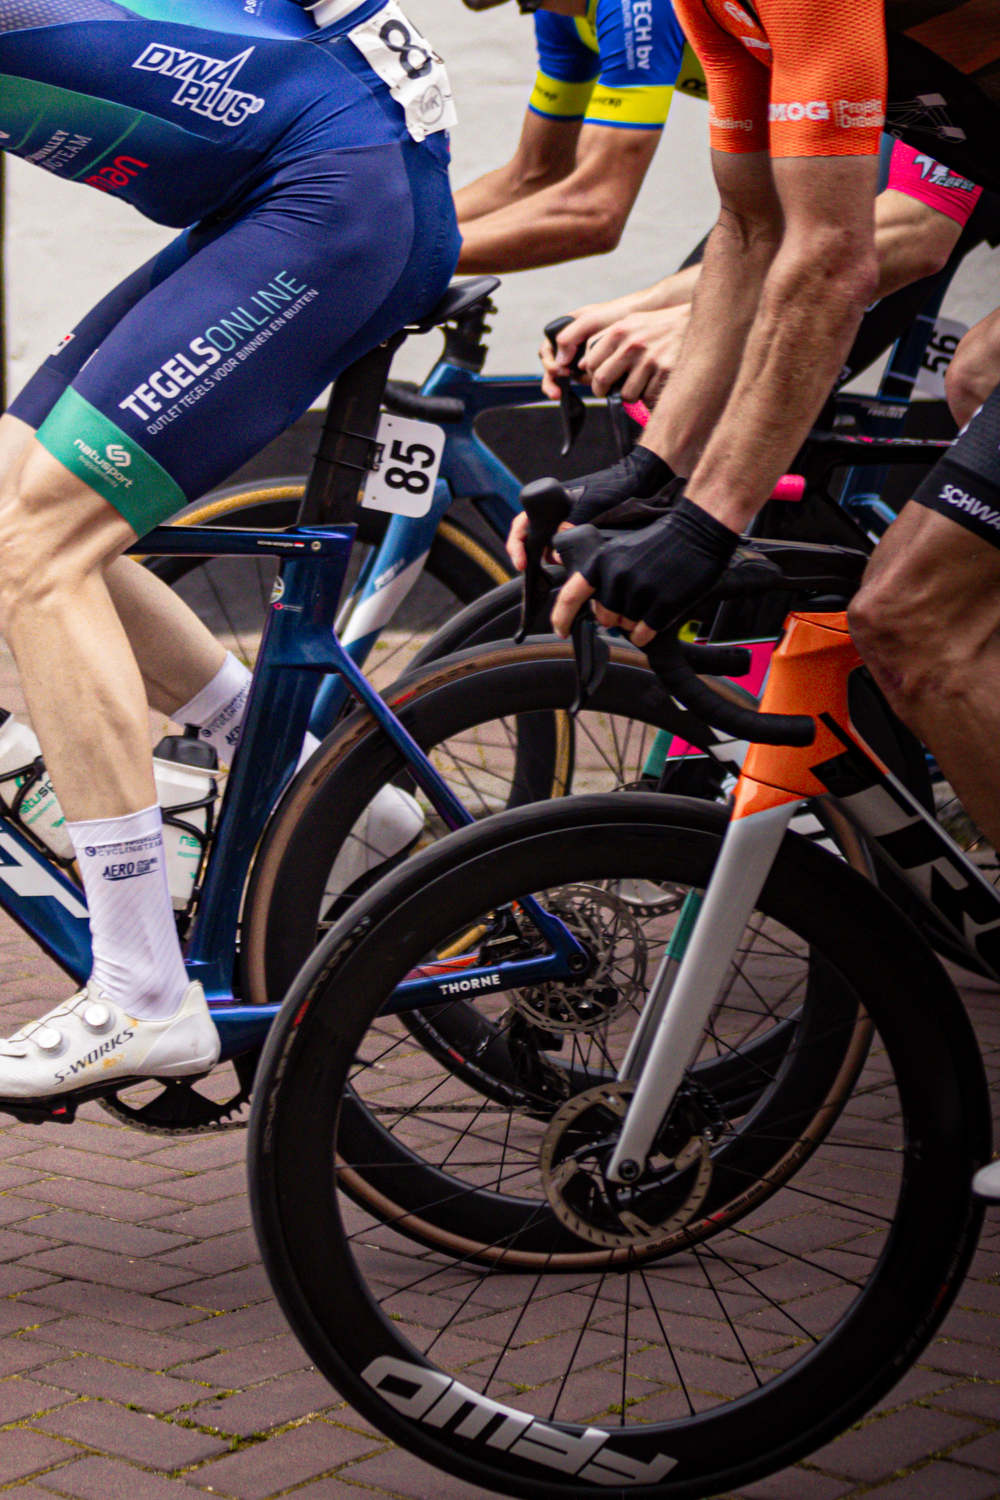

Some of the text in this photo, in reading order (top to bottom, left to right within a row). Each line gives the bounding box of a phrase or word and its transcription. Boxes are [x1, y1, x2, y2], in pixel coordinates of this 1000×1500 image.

[132, 43, 256, 94] DYNA
[146, 406, 183, 436] OUTLET
[178, 378, 216, 409] TEGELS
[212, 356, 241, 382] VOOR
[237, 324, 274, 362] BINNEN
[283, 288, 320, 322] BUITEN
[73, 438, 135, 489] natusport
[384, 438, 436, 495] 85
[102, 861, 135, 879] AERO
[439, 974, 502, 996] THORNE
[53, 1025, 135, 1086] S-WORKS
[360, 1355, 679, 1487] FFWD
